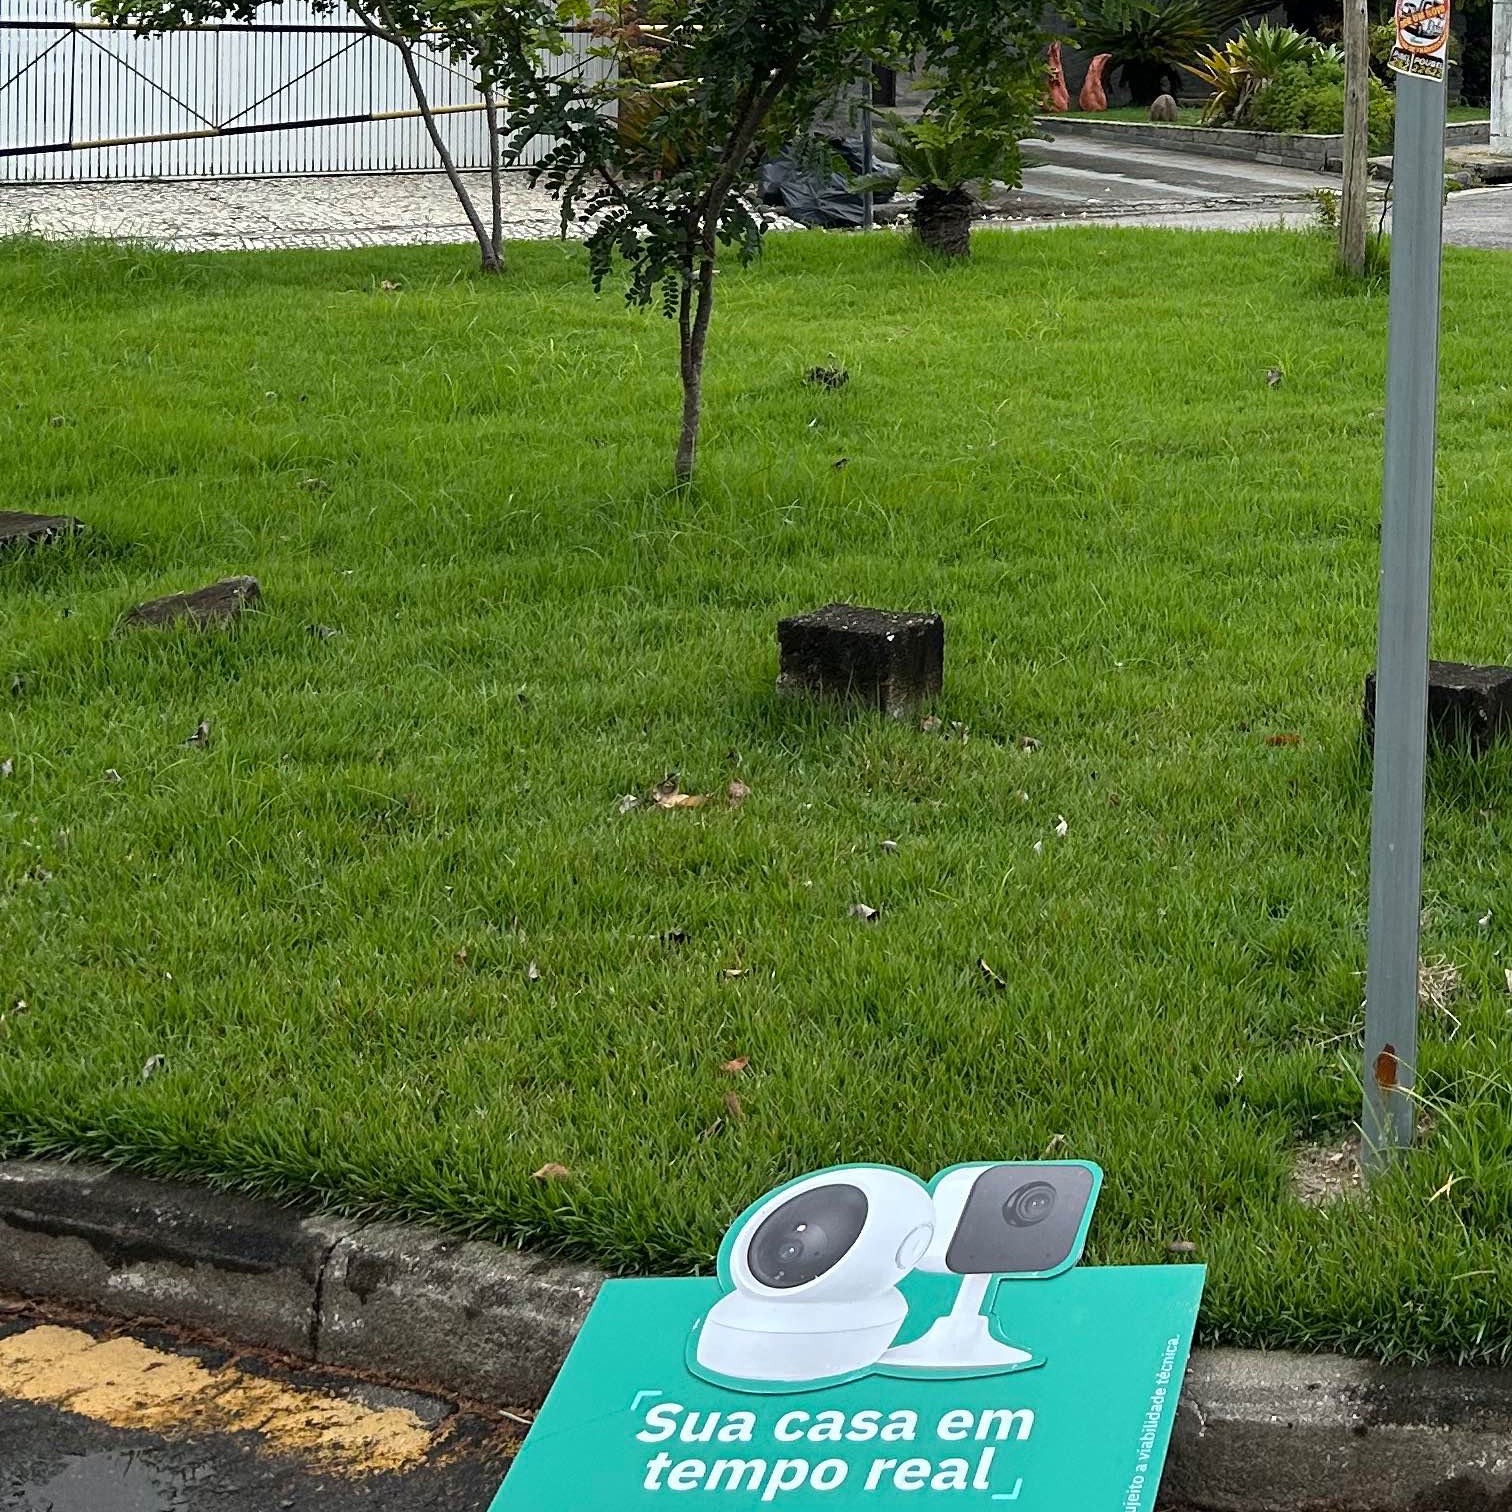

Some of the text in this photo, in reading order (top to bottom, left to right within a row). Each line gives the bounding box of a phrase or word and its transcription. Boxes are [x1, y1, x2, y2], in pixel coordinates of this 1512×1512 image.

[1156, 1333, 1181, 1385] técnica.
[636, 1403, 1035, 1443] Sua casa em
[1136, 1387, 1167, 1461] viabilidade
[643, 1446, 996, 1502] tempo real
[1135, 1463, 1148, 1473] a
